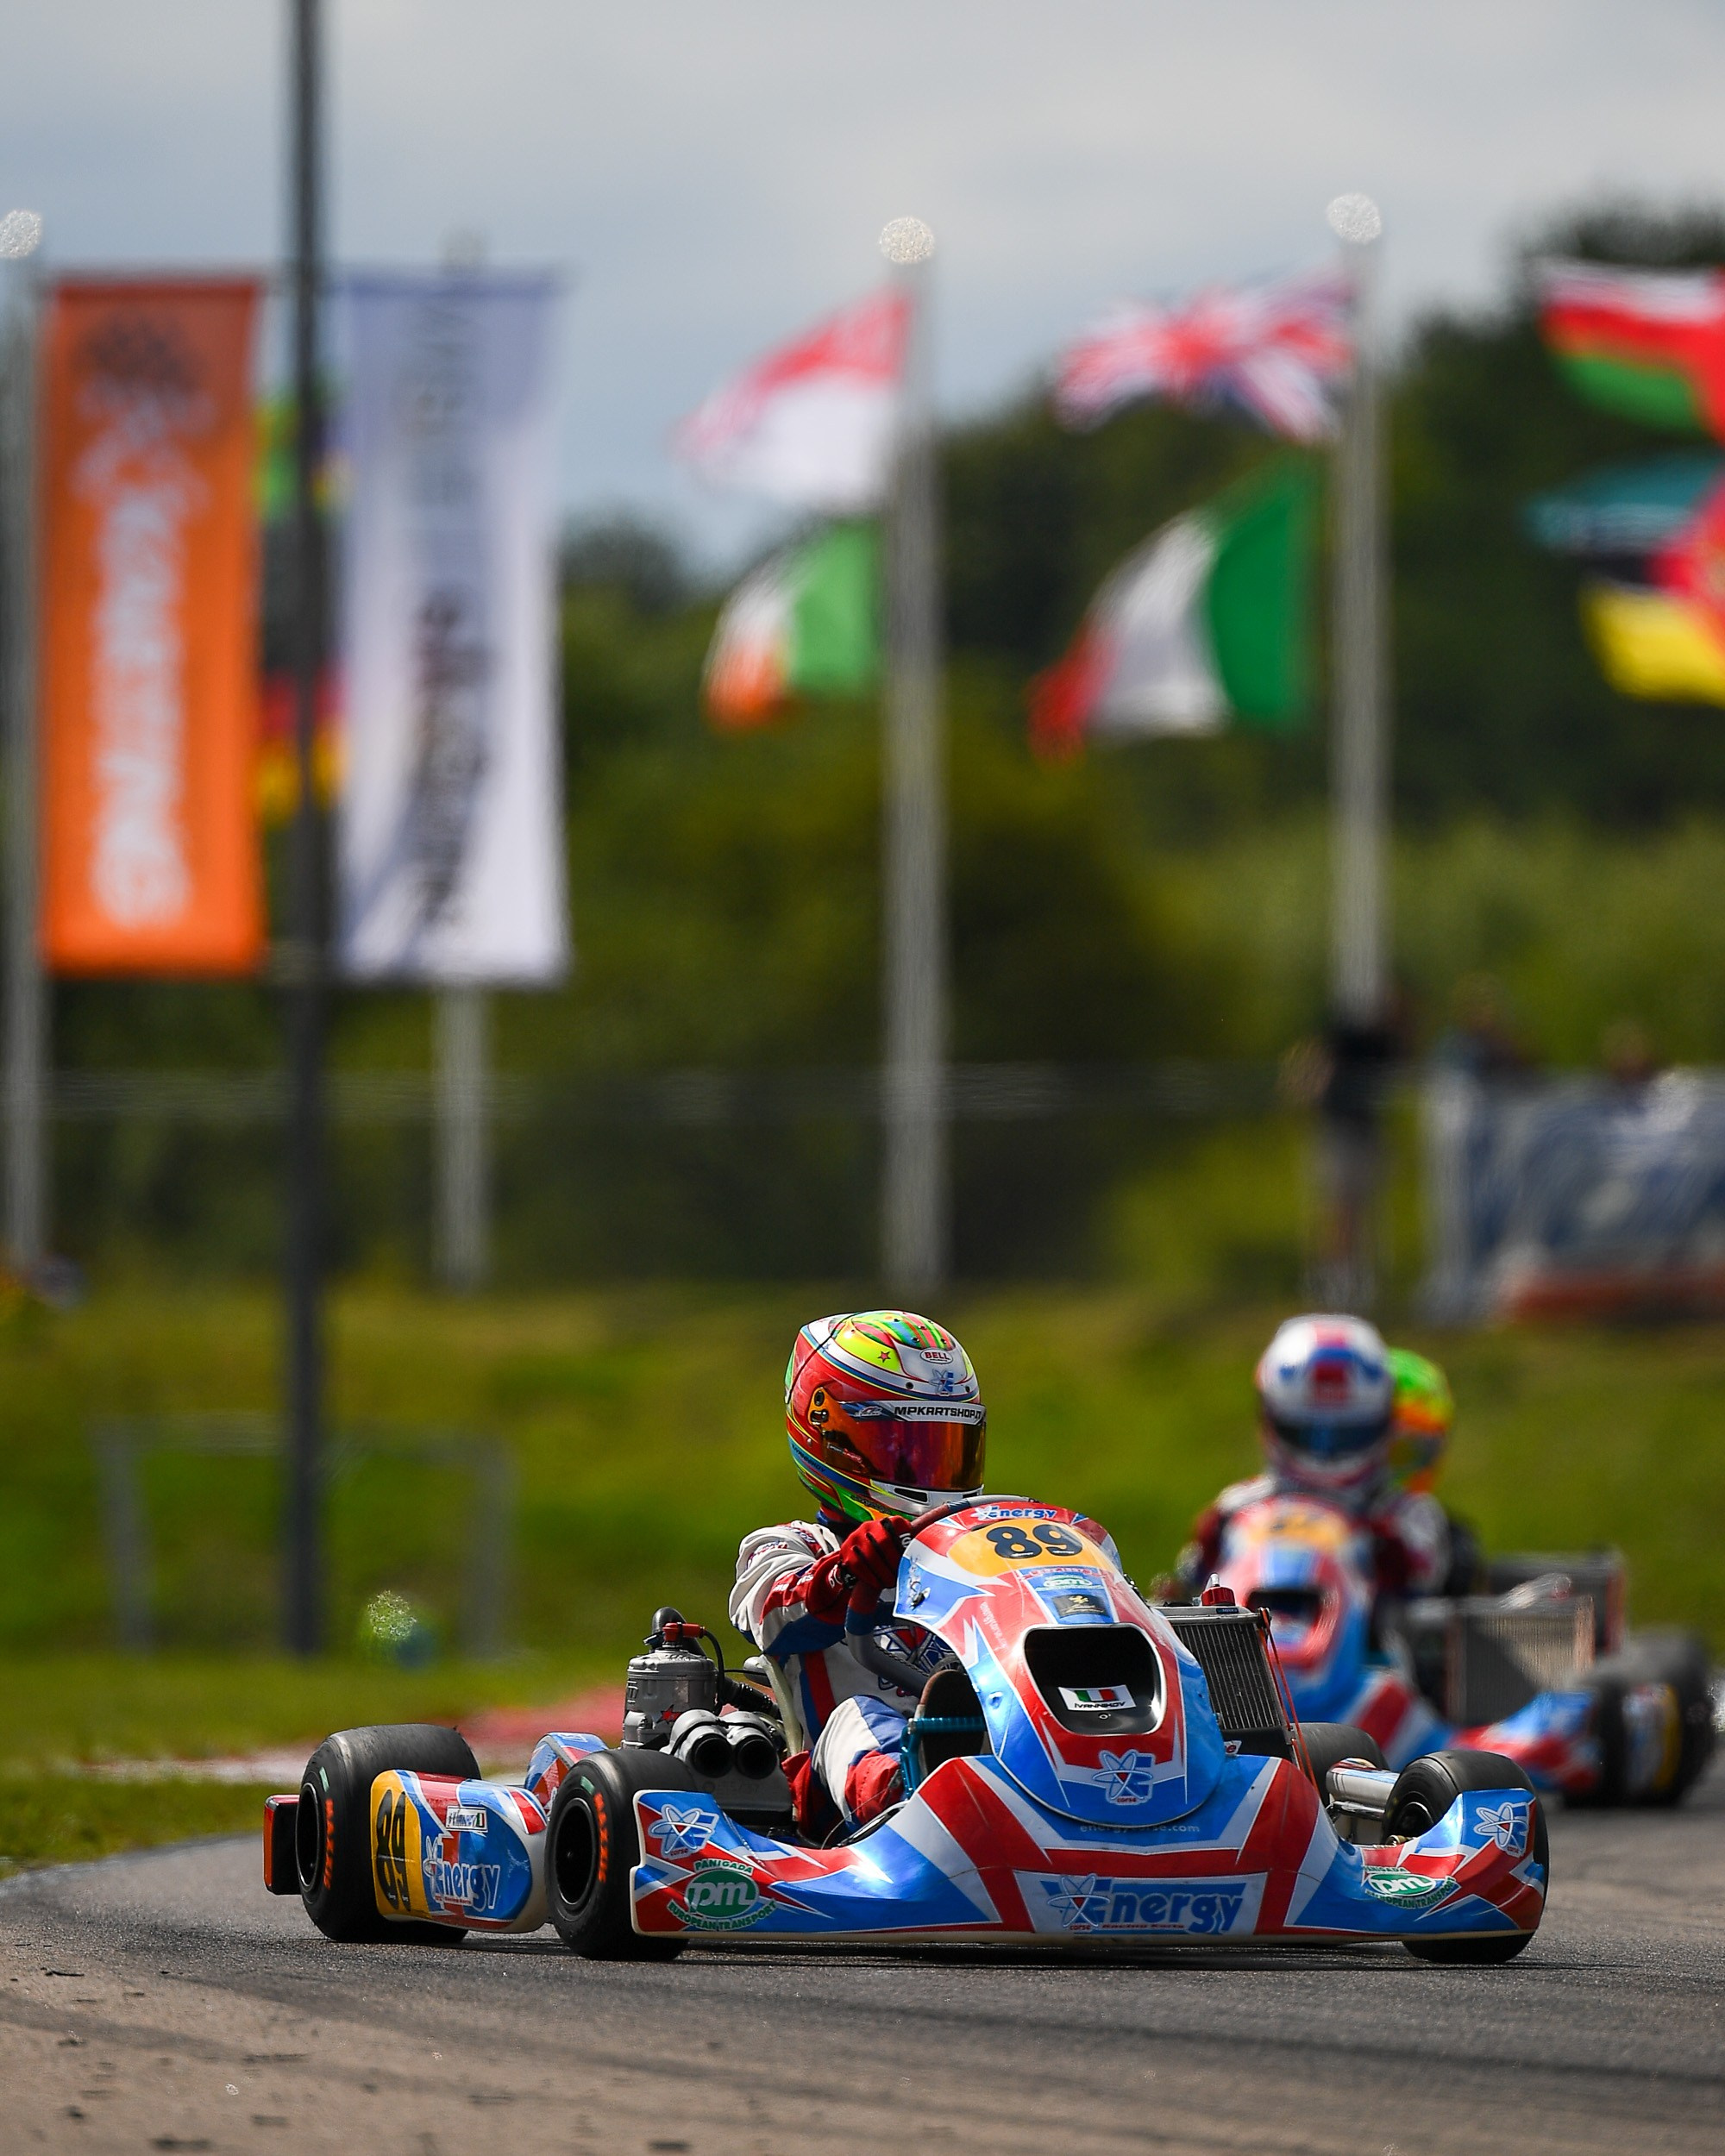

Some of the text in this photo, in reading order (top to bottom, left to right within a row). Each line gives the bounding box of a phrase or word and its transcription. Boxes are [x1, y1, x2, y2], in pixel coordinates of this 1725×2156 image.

[925, 1351, 951, 1361] BELL
[986, 1506, 1056, 1520] Energy
[986, 1523, 1083, 1559] 89
[375, 1789, 411, 1912] 89
[428, 1842, 500, 1910] Energy
[695, 1860, 753, 1875] PANIGADA
[668, 1901, 777, 1931] EUROPEAN TRANSPORT
[1068, 1877, 1244, 1934] Energy
